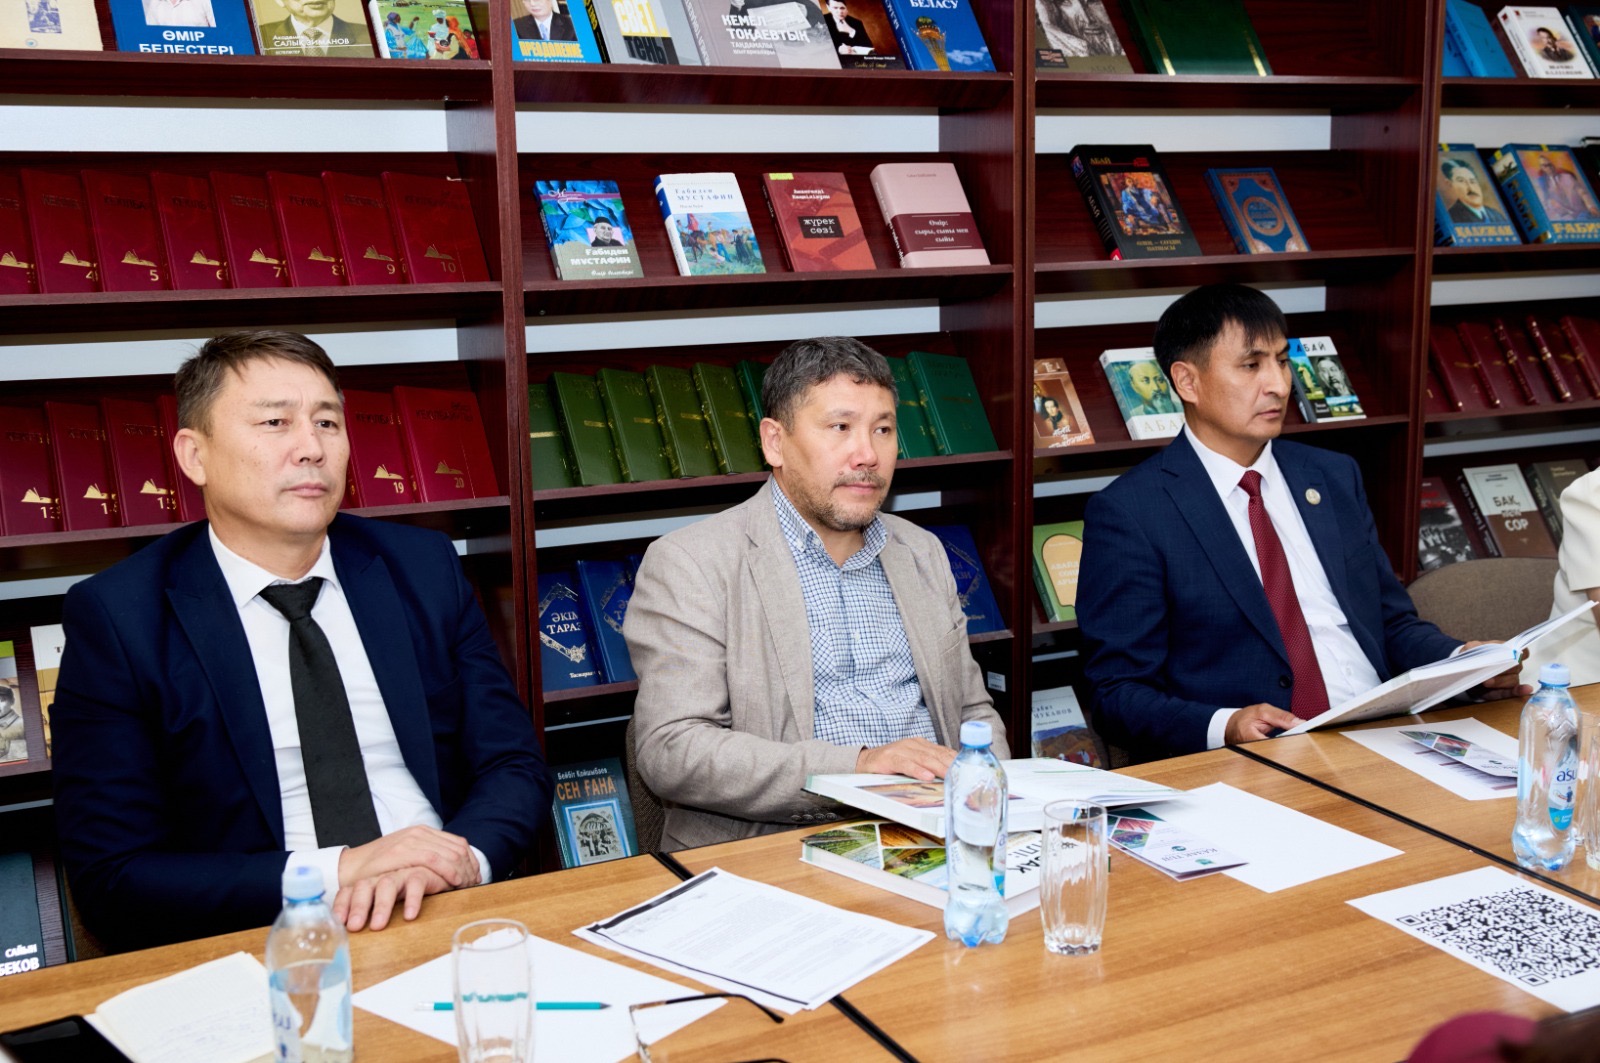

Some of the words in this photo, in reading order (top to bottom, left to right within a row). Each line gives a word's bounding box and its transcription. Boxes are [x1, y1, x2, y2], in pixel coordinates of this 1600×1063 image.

[614, 0, 657, 34] СВЕТ
[721, 14, 767, 26] КЕМЕЛ
[162, 30, 205, 42] ӨМІР
[726, 28, 811, 42] ТОҚАЕВТЫҢ
[139, 43, 234, 56] БЕЛЕСТЕРІ
[386, 264, 396, 275] 9
[440, 261, 456, 273] 10
[150, 269, 159, 281] 5
[393, 481, 405, 494] 19
[454, 477, 465, 488] 20
[1504, 518, 1529, 531] СОР
[556, 781, 581, 800] СЕН
[584, 775, 616, 797] ҒАНА
